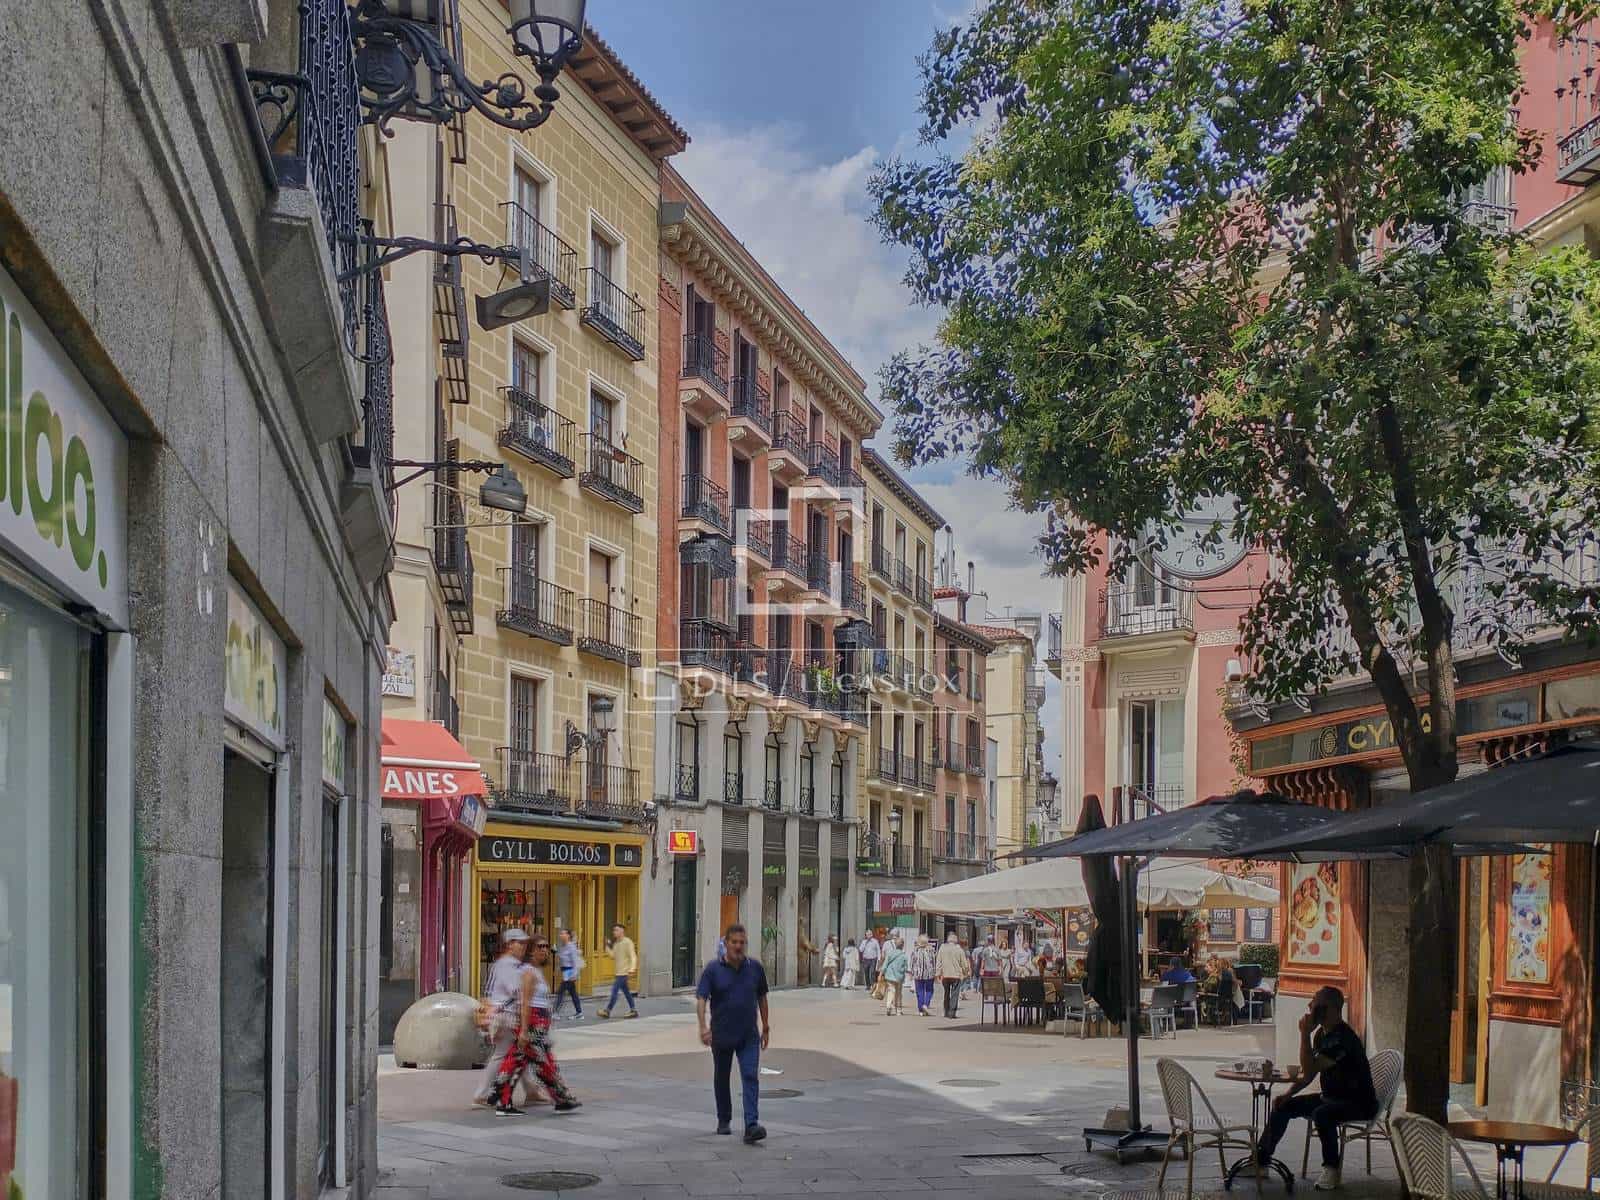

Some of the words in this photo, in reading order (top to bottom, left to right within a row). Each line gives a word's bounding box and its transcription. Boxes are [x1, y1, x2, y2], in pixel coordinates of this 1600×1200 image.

[1175, 552, 1184, 564] 7
[1195, 555, 1205, 567] 6
[1217, 548, 1225, 561] 5
[384, 769, 459, 794] ANES
[492, 840, 536, 861] GYLL
[550, 843, 601, 863] BOLSOS
